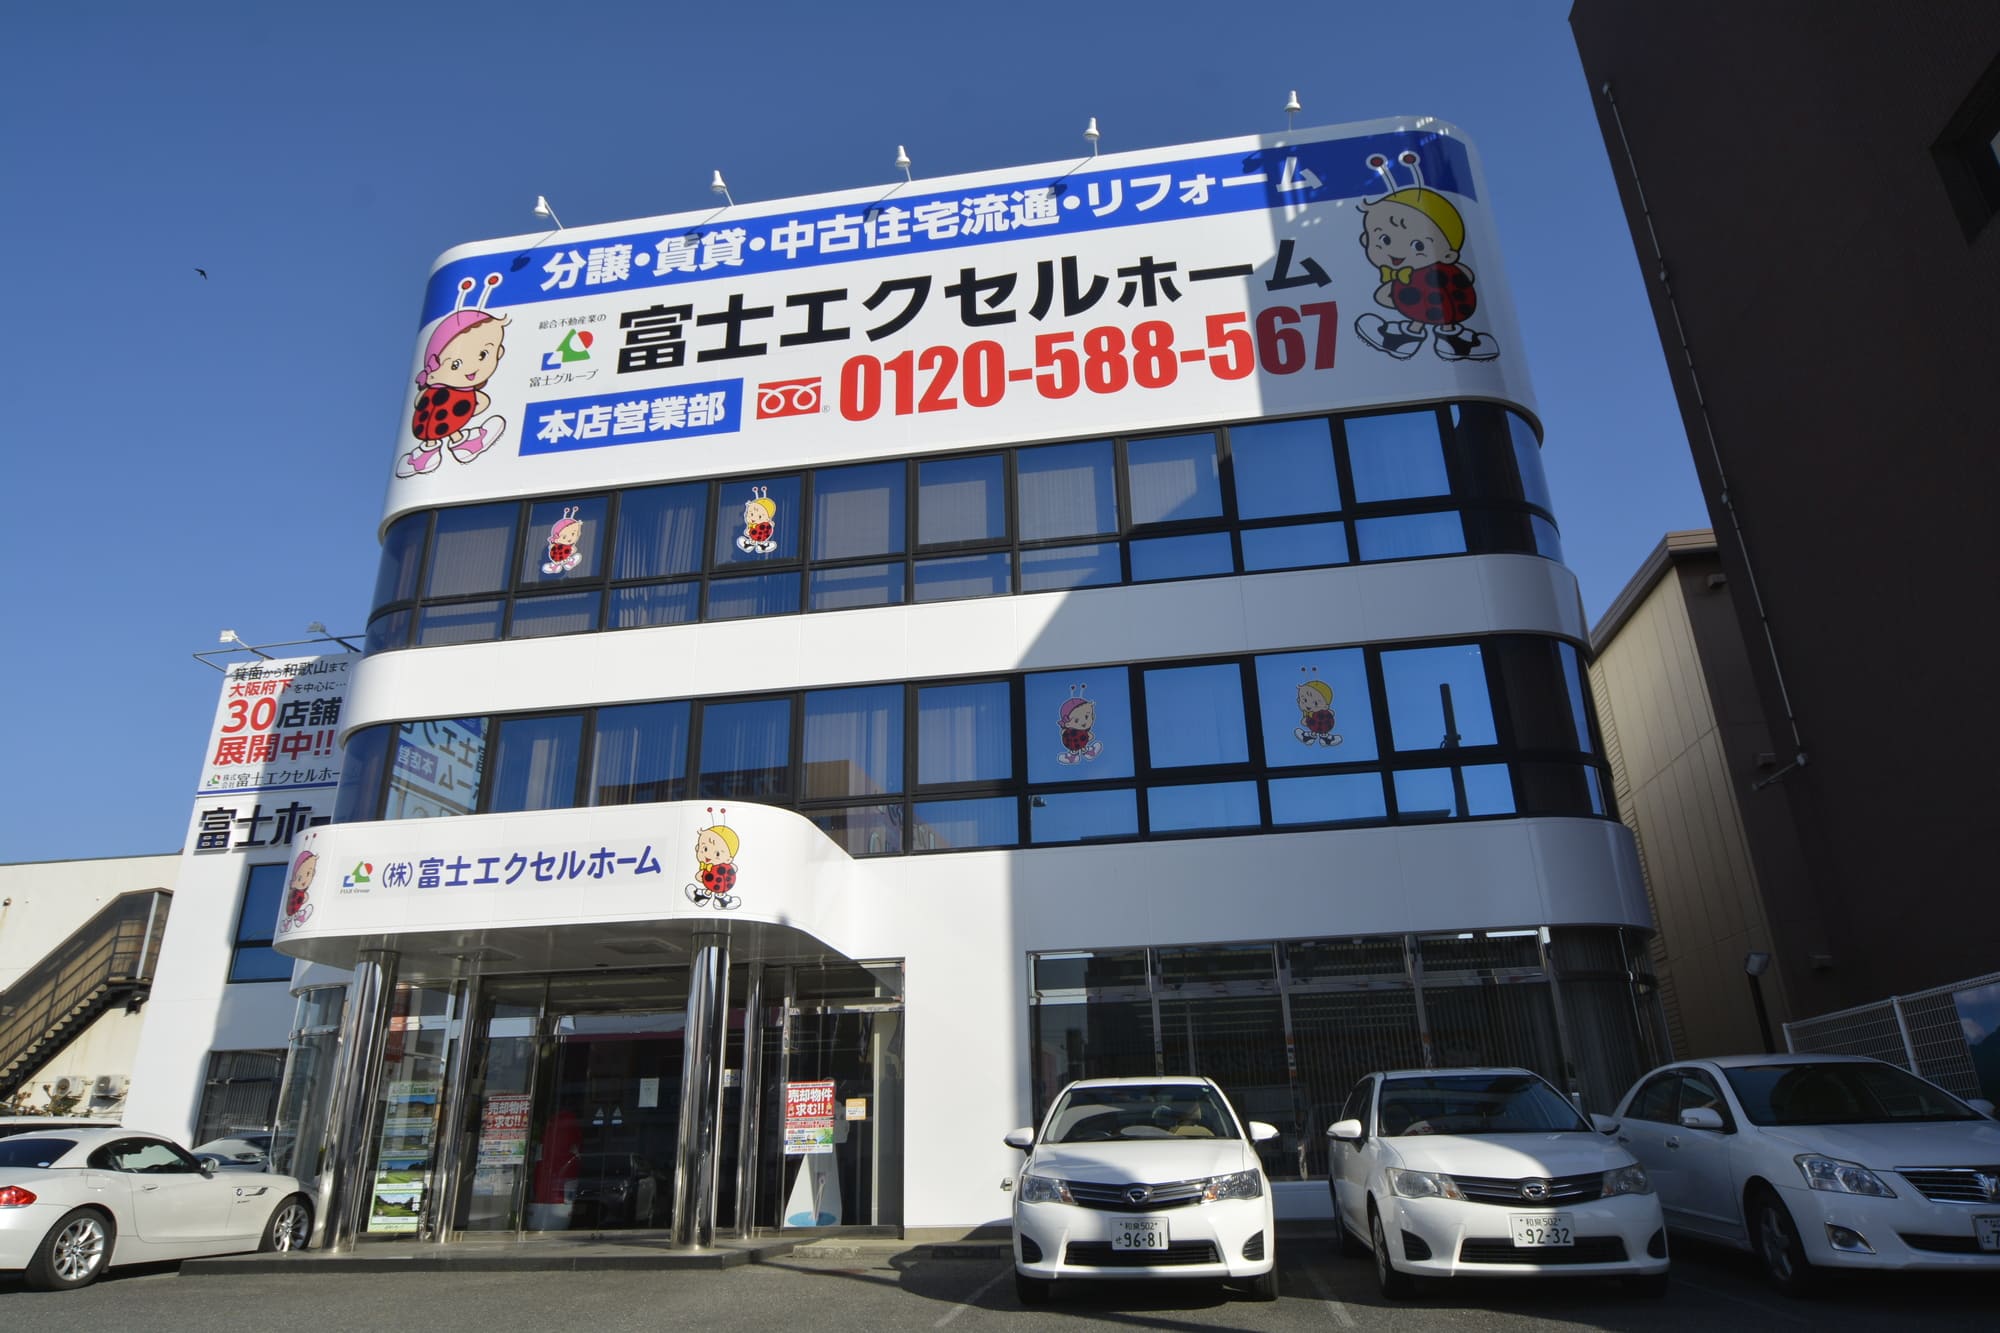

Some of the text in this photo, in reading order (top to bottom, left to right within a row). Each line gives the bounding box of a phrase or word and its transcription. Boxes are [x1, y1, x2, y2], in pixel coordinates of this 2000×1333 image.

[541, 154, 1323, 292] 分譲・賃貸・中古住宅流通・リフォーム
[617, 239, 1332, 375] 富士エクセルホーム
[538, 313, 607, 330] 総合不動産業の
[839, 301, 1339, 422] 0120-588-567
[529, 369, 599, 388] 富士グループ
[537, 393, 726, 444] 本店営業部
[234, 661, 347, 681] 箕面から和歌山まで
[221, 697, 343, 733] 30店舗
[788, 1088, 832, 1103] 売却物件
[489, 1101, 530, 1115] 売却物件
[1124, 1231, 1163, 1248] 96-81
[1526, 1228, 1571, 1244] 92-32
